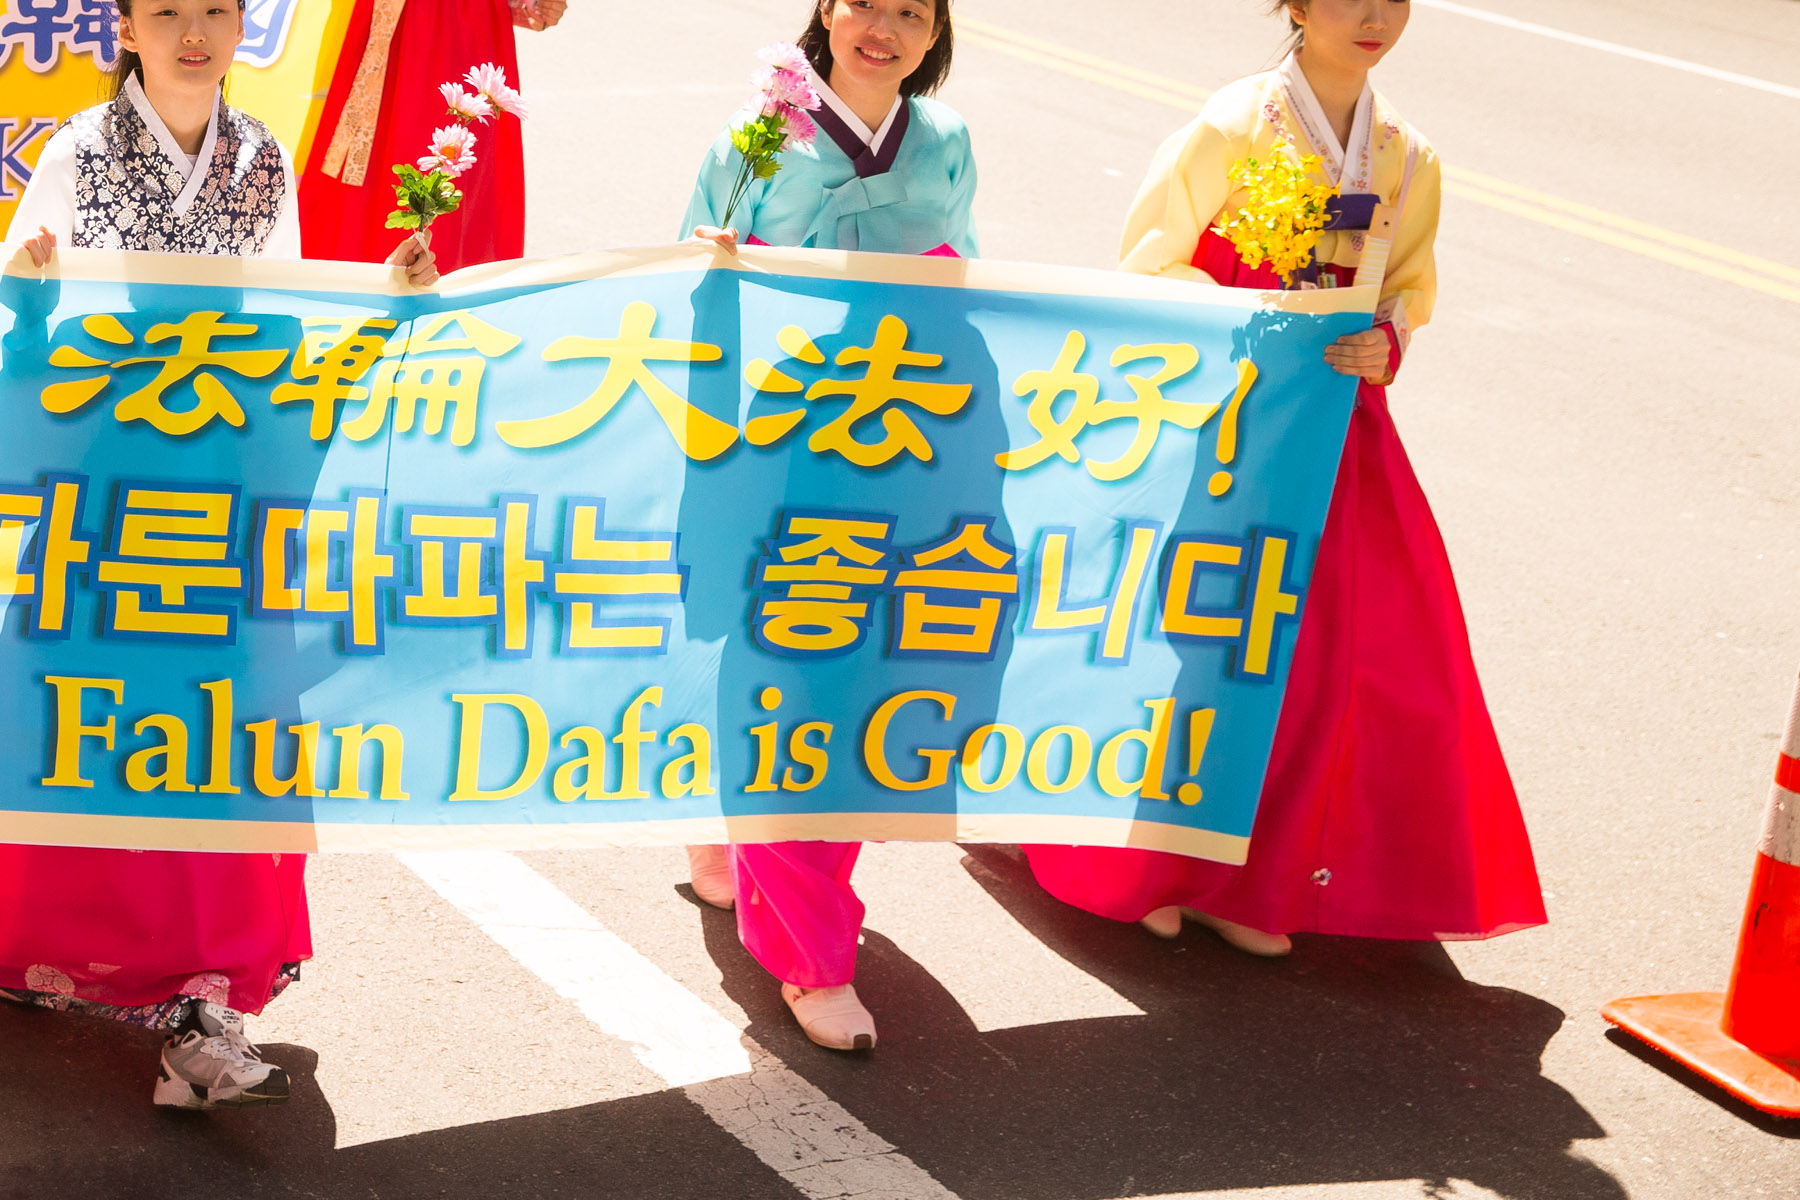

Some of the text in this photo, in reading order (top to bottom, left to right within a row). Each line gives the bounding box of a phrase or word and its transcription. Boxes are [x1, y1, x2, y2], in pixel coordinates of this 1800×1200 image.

[755, 508, 1300, 678] 좋습니다
[40, 674, 1216, 807] Falun Dafa is Good!
